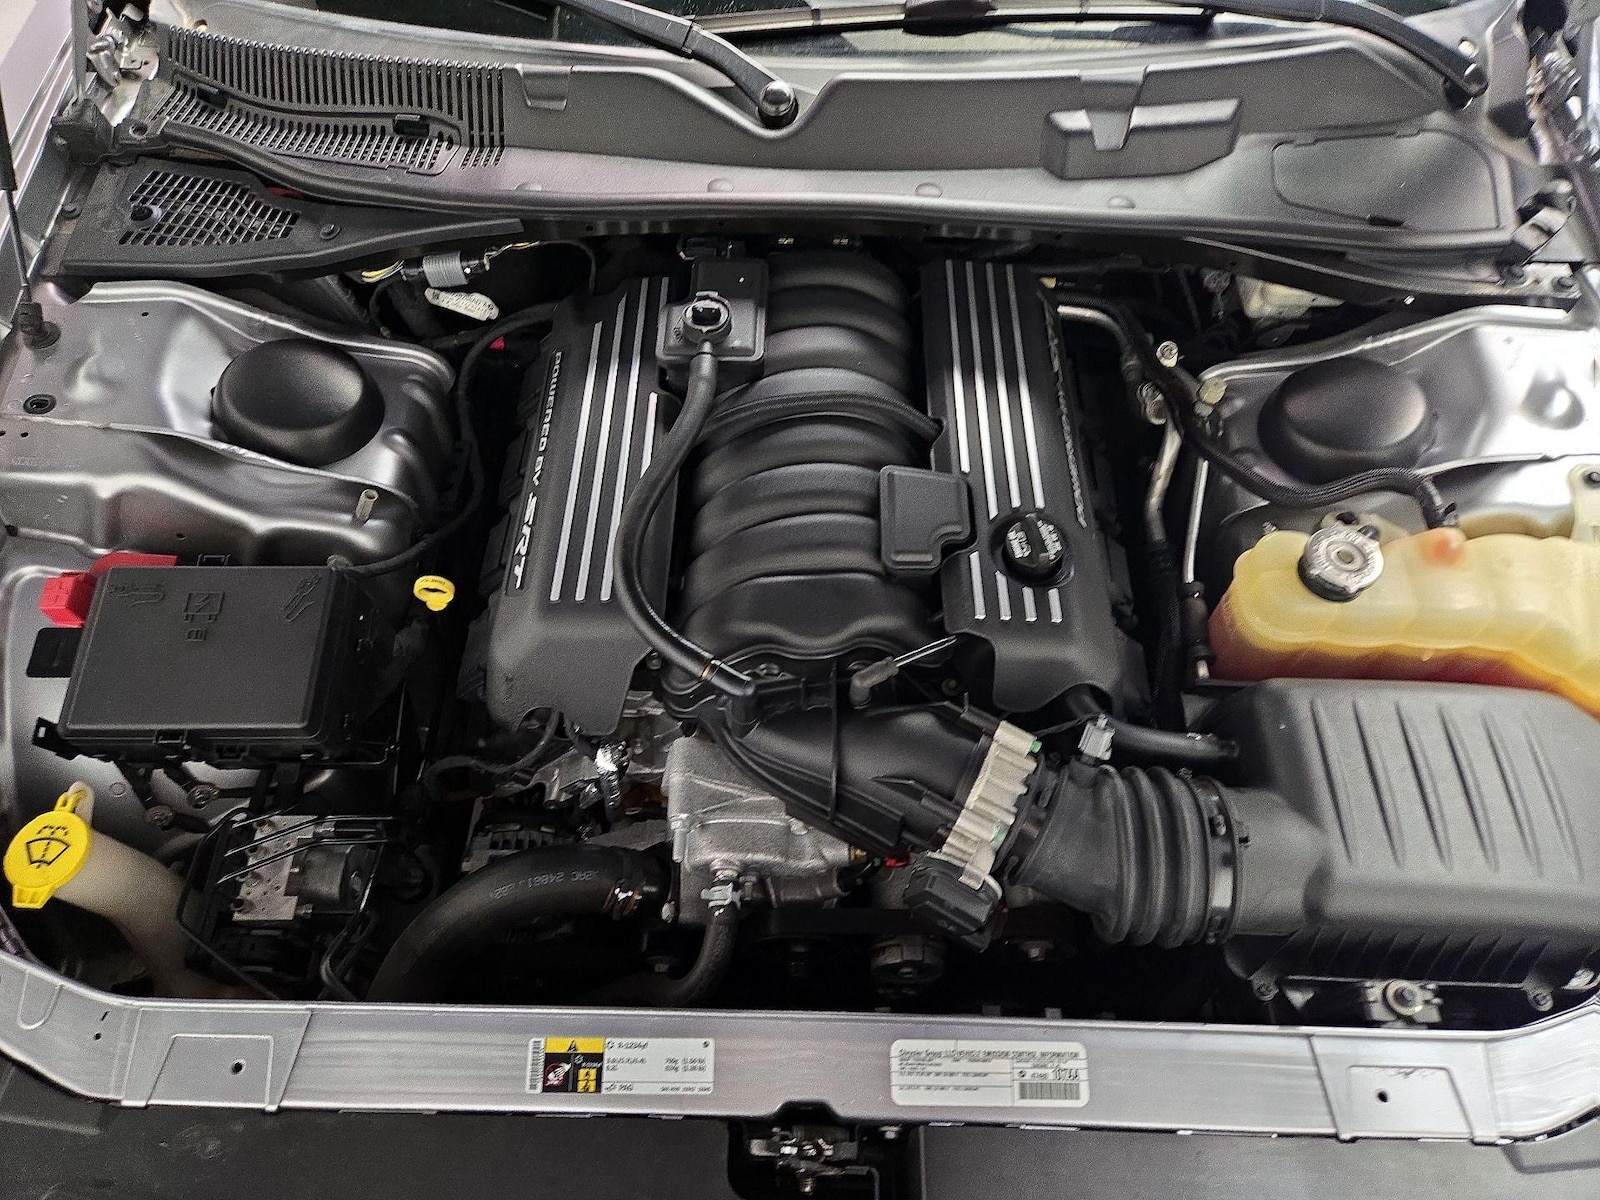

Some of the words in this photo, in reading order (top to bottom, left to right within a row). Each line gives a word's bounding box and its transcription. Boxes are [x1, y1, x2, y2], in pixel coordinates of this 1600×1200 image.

[538, 351, 562, 452] POWERED
[532, 455, 544, 487] BY
[513, 491, 538, 590] SRT
